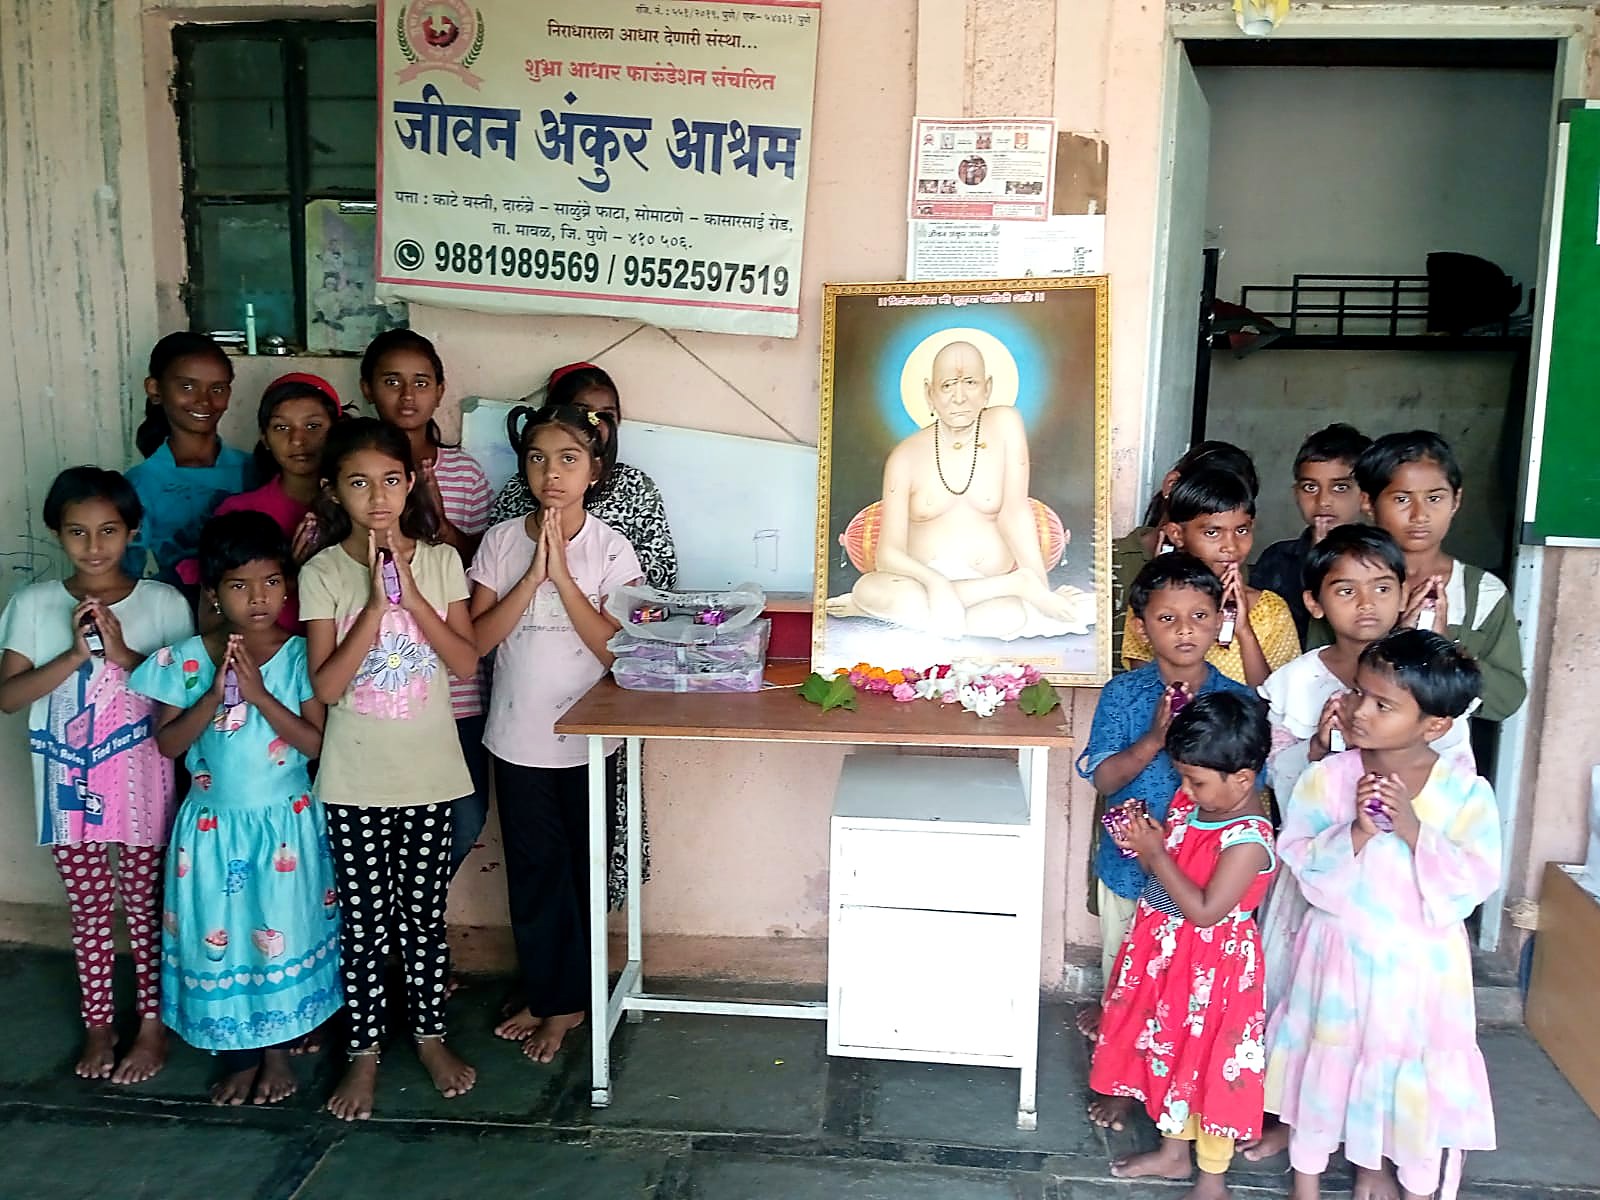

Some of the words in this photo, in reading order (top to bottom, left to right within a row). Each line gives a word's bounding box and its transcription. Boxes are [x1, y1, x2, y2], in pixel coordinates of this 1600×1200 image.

[547, 19, 614, 40] निराधाराला
[620, 27, 659, 44] आधार
[664, 26, 700, 46] देणारी
[705, 28, 758, 49] संस्था...
[524, 57, 562, 83] शुभ्रा
[568, 61, 622, 81] आधार
[626, 61, 707, 86] फाऊंडेशन
[712, 66, 776, 90] संचलित
[393, 83, 521, 161] जीवन
[534, 91, 652, 193] अंकुर
[666, 117, 802, 181] आश्रम
[432, 190, 458, 207] काटे
[635, 204, 684, 223] सोमाटणे
[704, 212, 765, 232] कासारसाई
[492, 222, 510, 236] ता.
[560, 223, 581, 240] जि.
[585, 226, 608, 246] पुणे
[434, 240, 600, 285] 9881989569
[607, 254, 617, 285] /
[624, 254, 790, 297] 9552597519
[92, 742, 111, 762] Find
